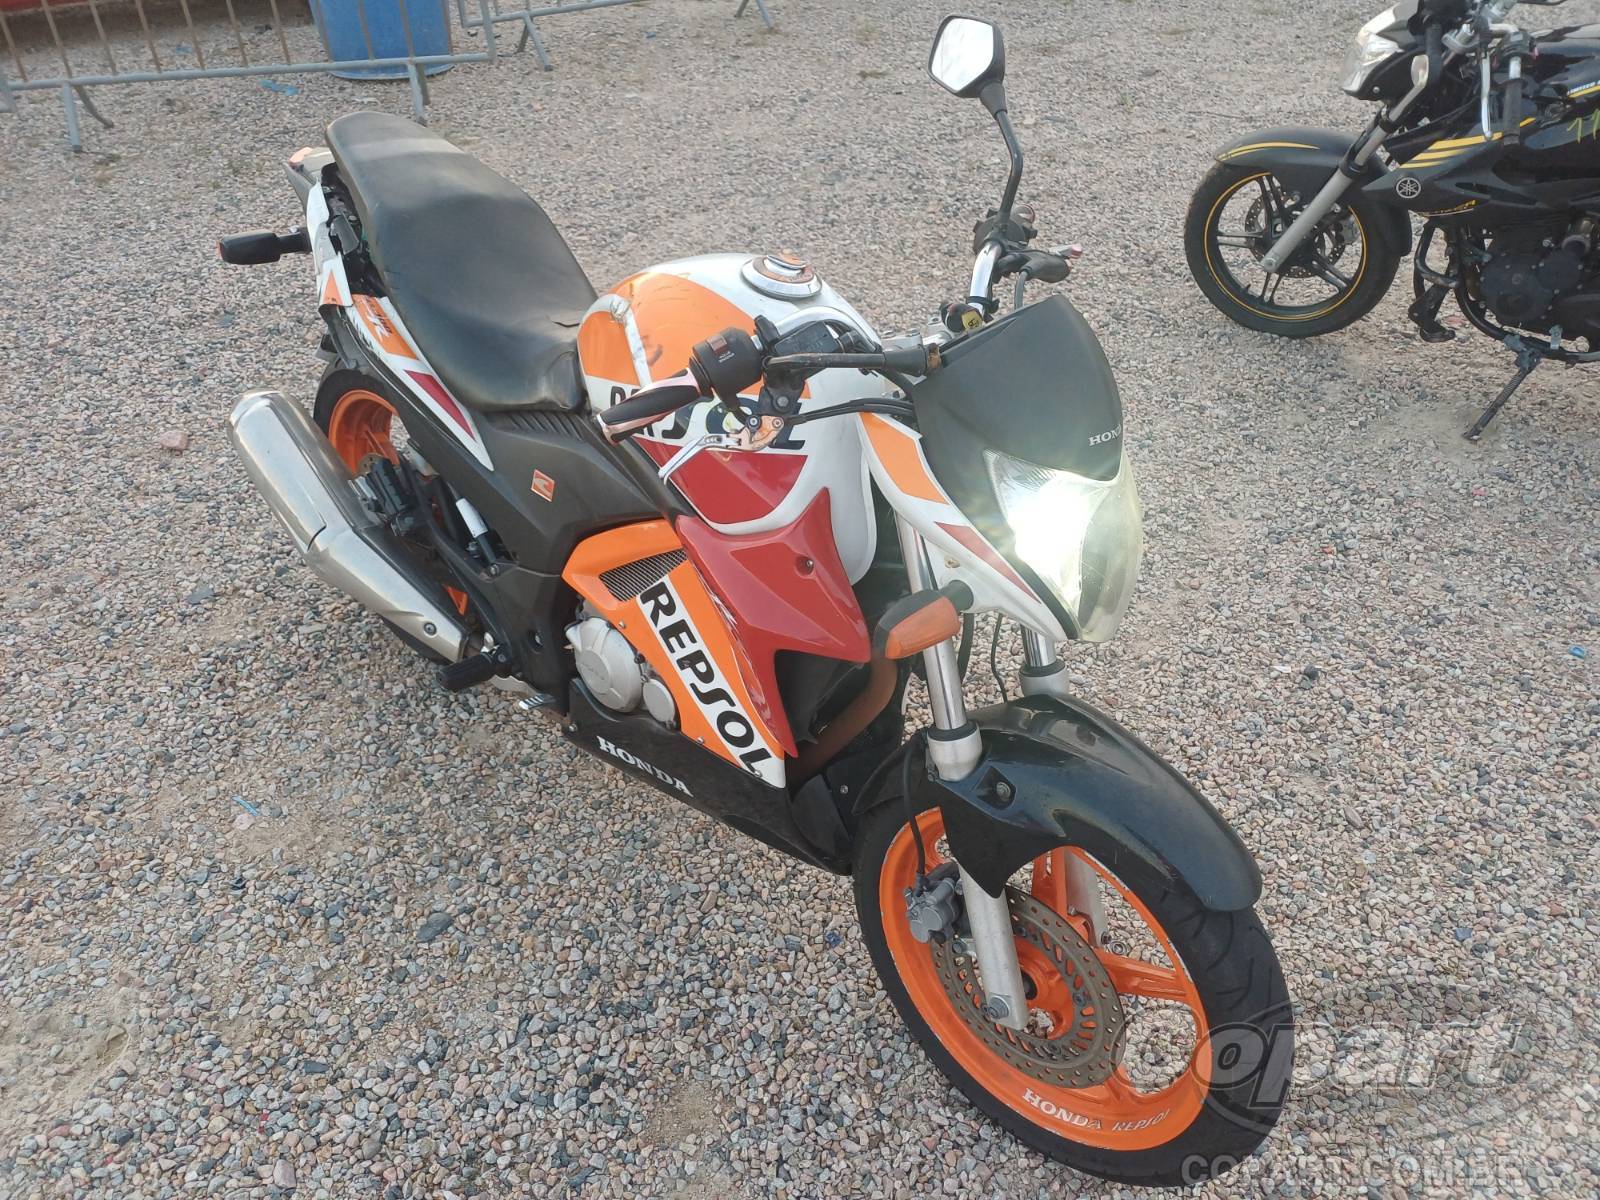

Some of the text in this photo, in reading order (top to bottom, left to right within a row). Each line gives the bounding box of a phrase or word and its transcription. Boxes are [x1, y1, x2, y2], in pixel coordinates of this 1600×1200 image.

[640, 581, 772, 773] REPSOL
[596, 735, 694, 798] HONDA
[1022, 1087, 1103, 1131] HONDA
